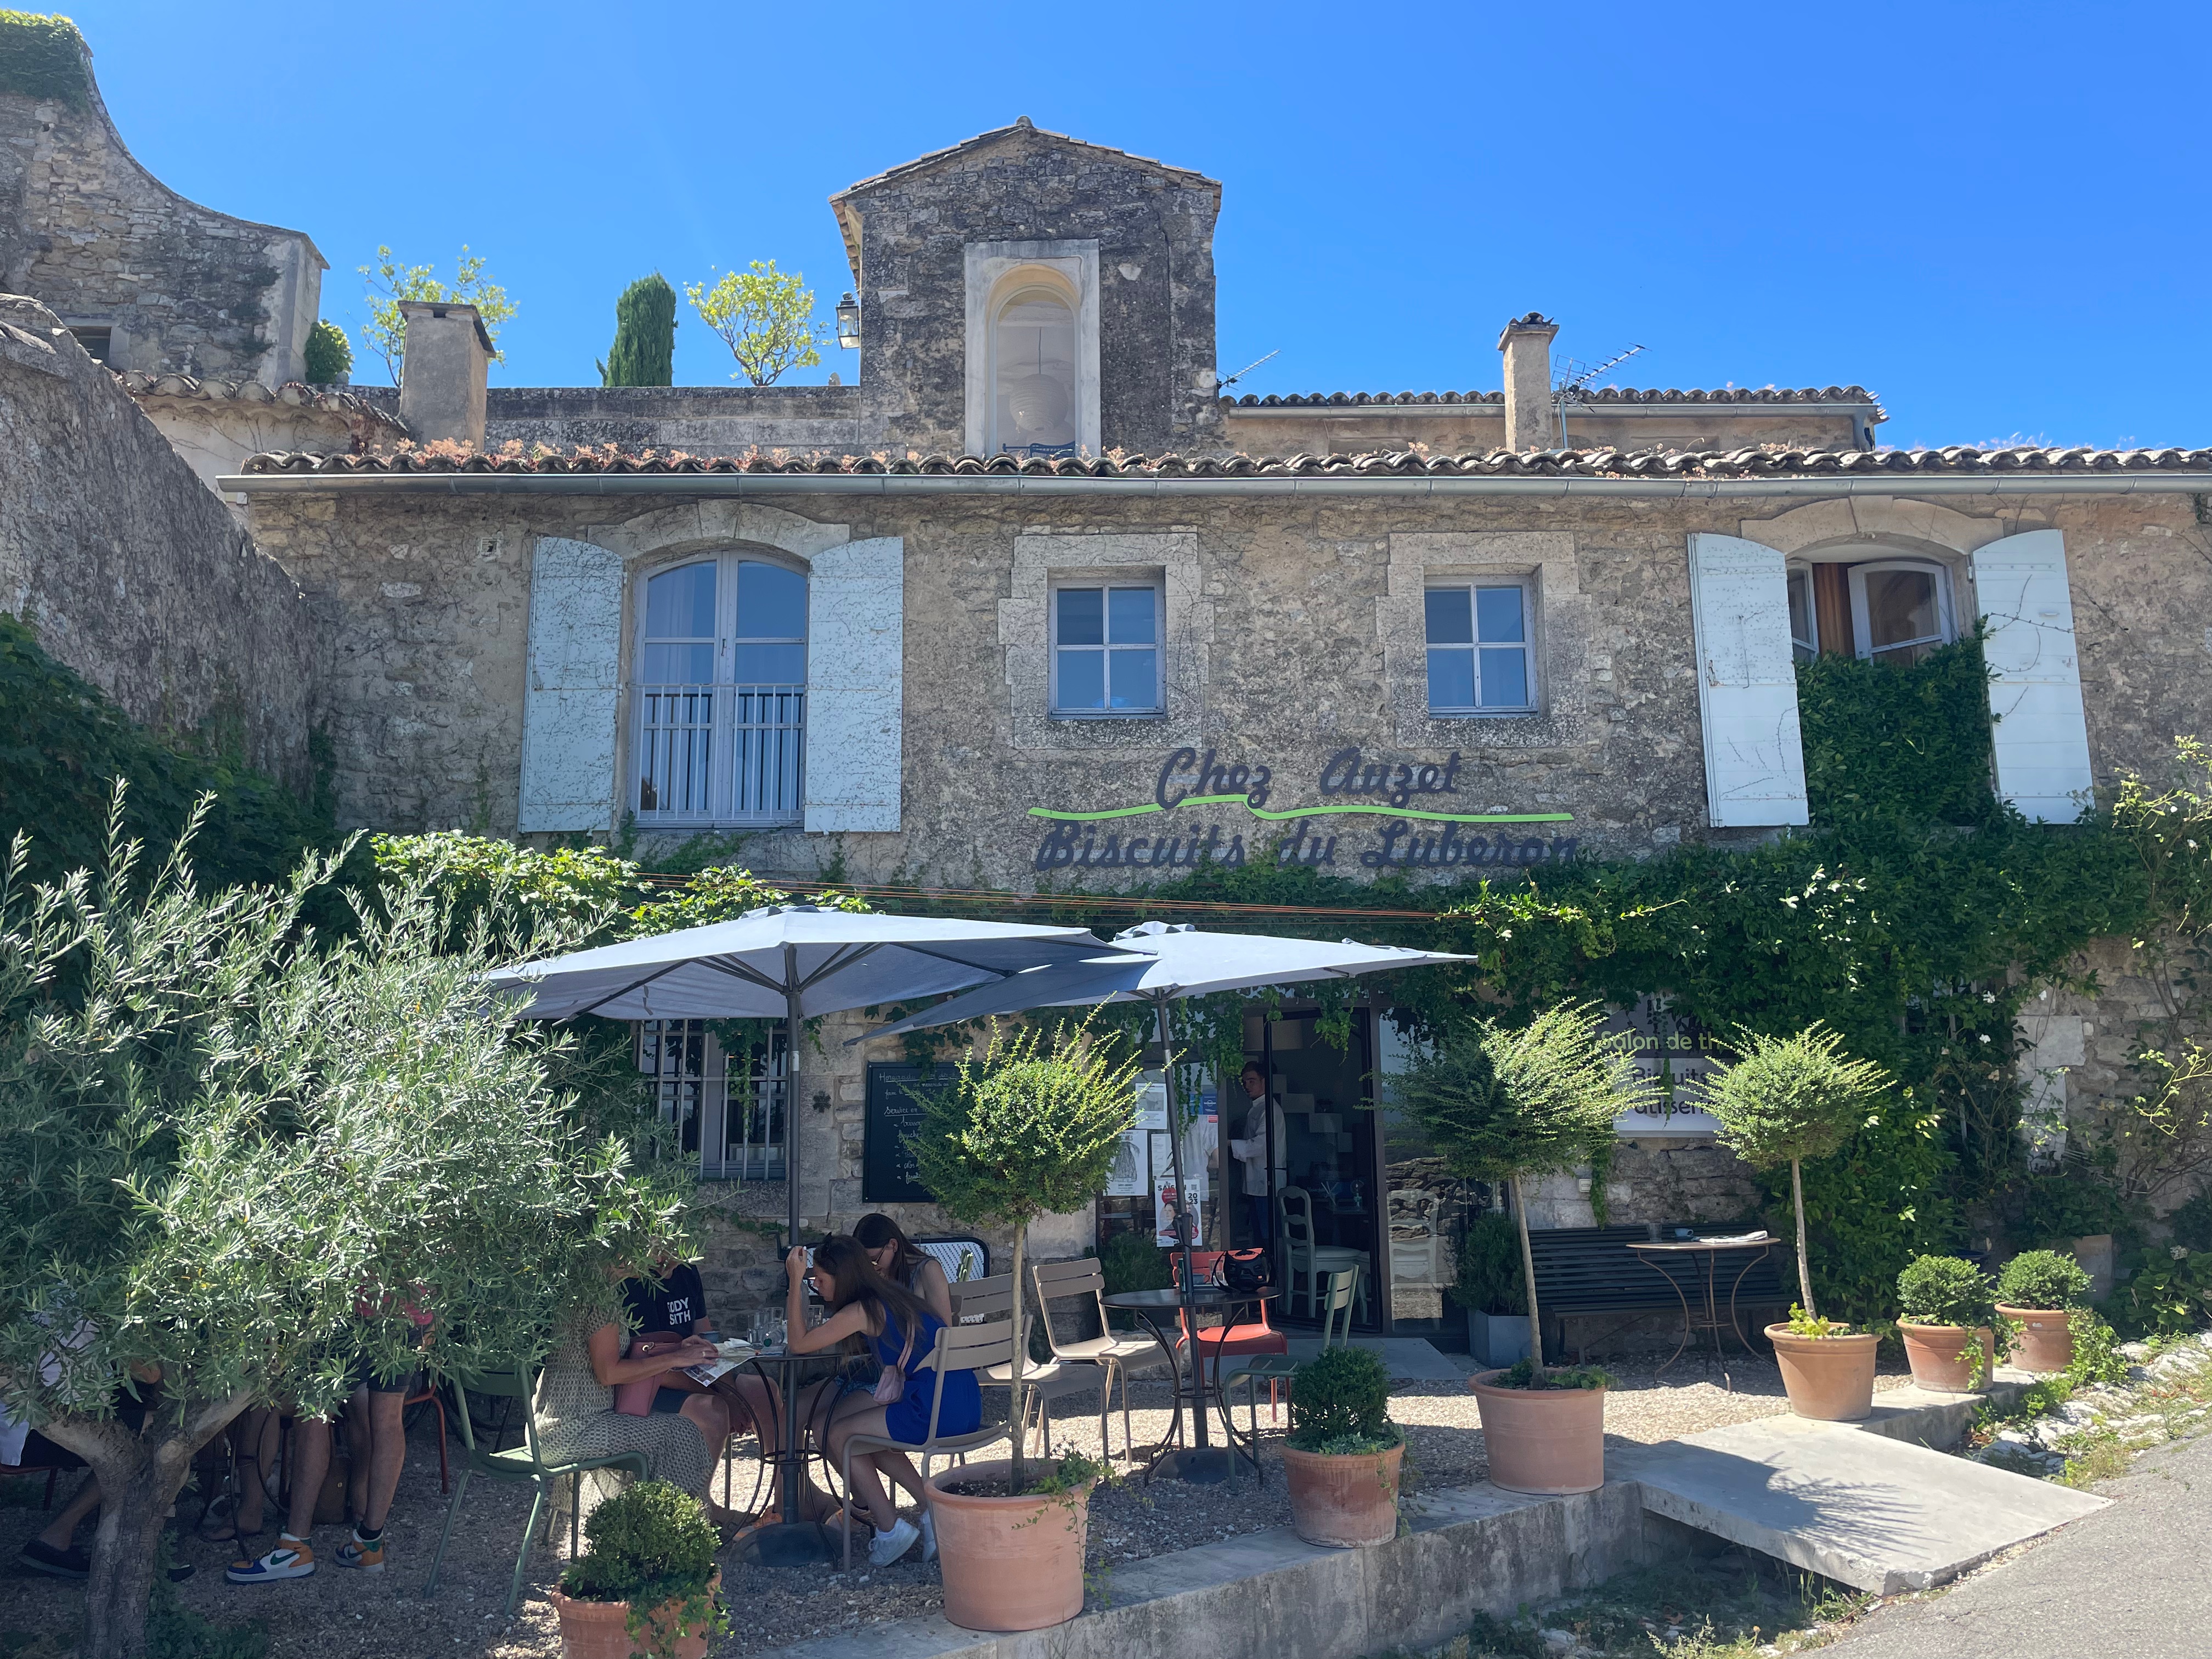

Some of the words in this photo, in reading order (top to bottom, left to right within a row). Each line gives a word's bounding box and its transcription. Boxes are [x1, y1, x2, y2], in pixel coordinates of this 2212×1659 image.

[1157, 747, 1271, 809] Chez
[1319, 747, 1462, 809] Auzet
[1036, 820, 1245, 871] Biscuits
[1277, 820, 1337, 867] du
[1361, 820, 1577, 867] Luberon
[1600, 1030, 1659, 1050] Salon
[1666, 1031, 1692, 1050] de
[1698, 1031, 1728, 1050] th
[1632, 1067, 1707, 1085] Bisuits
